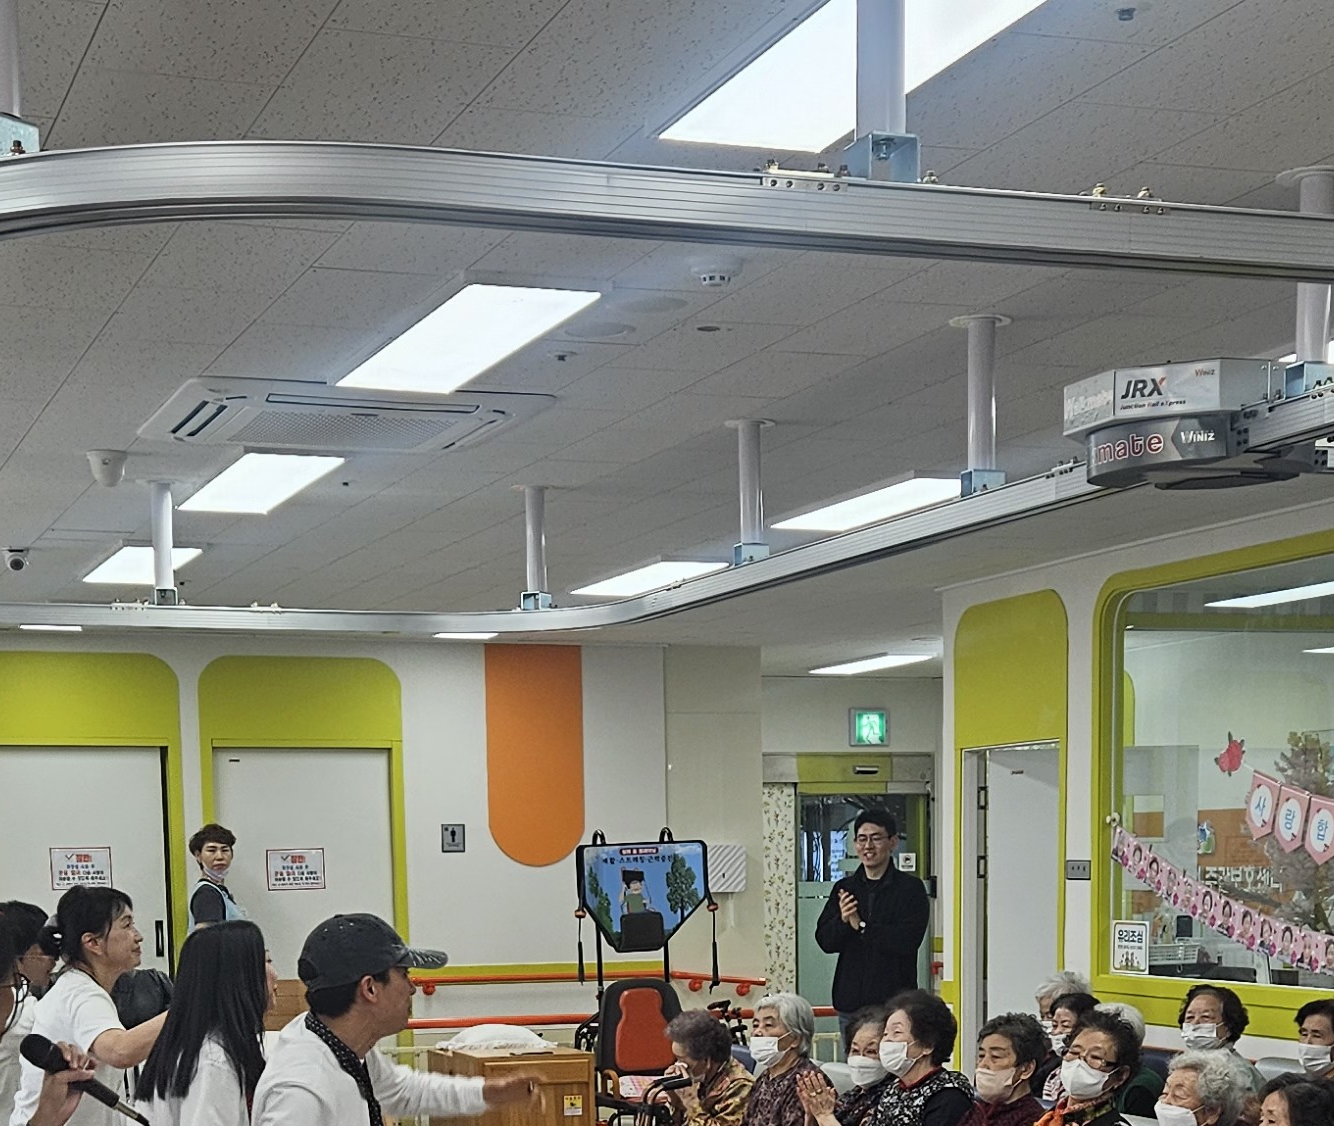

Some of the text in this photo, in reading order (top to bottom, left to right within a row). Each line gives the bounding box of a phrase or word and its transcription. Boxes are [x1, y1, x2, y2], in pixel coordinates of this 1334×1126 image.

[1121, 376, 1166, 400] JRX
[1096, 433, 1164, 465] mate
[1117, 929, 1144, 944] 유리조심
